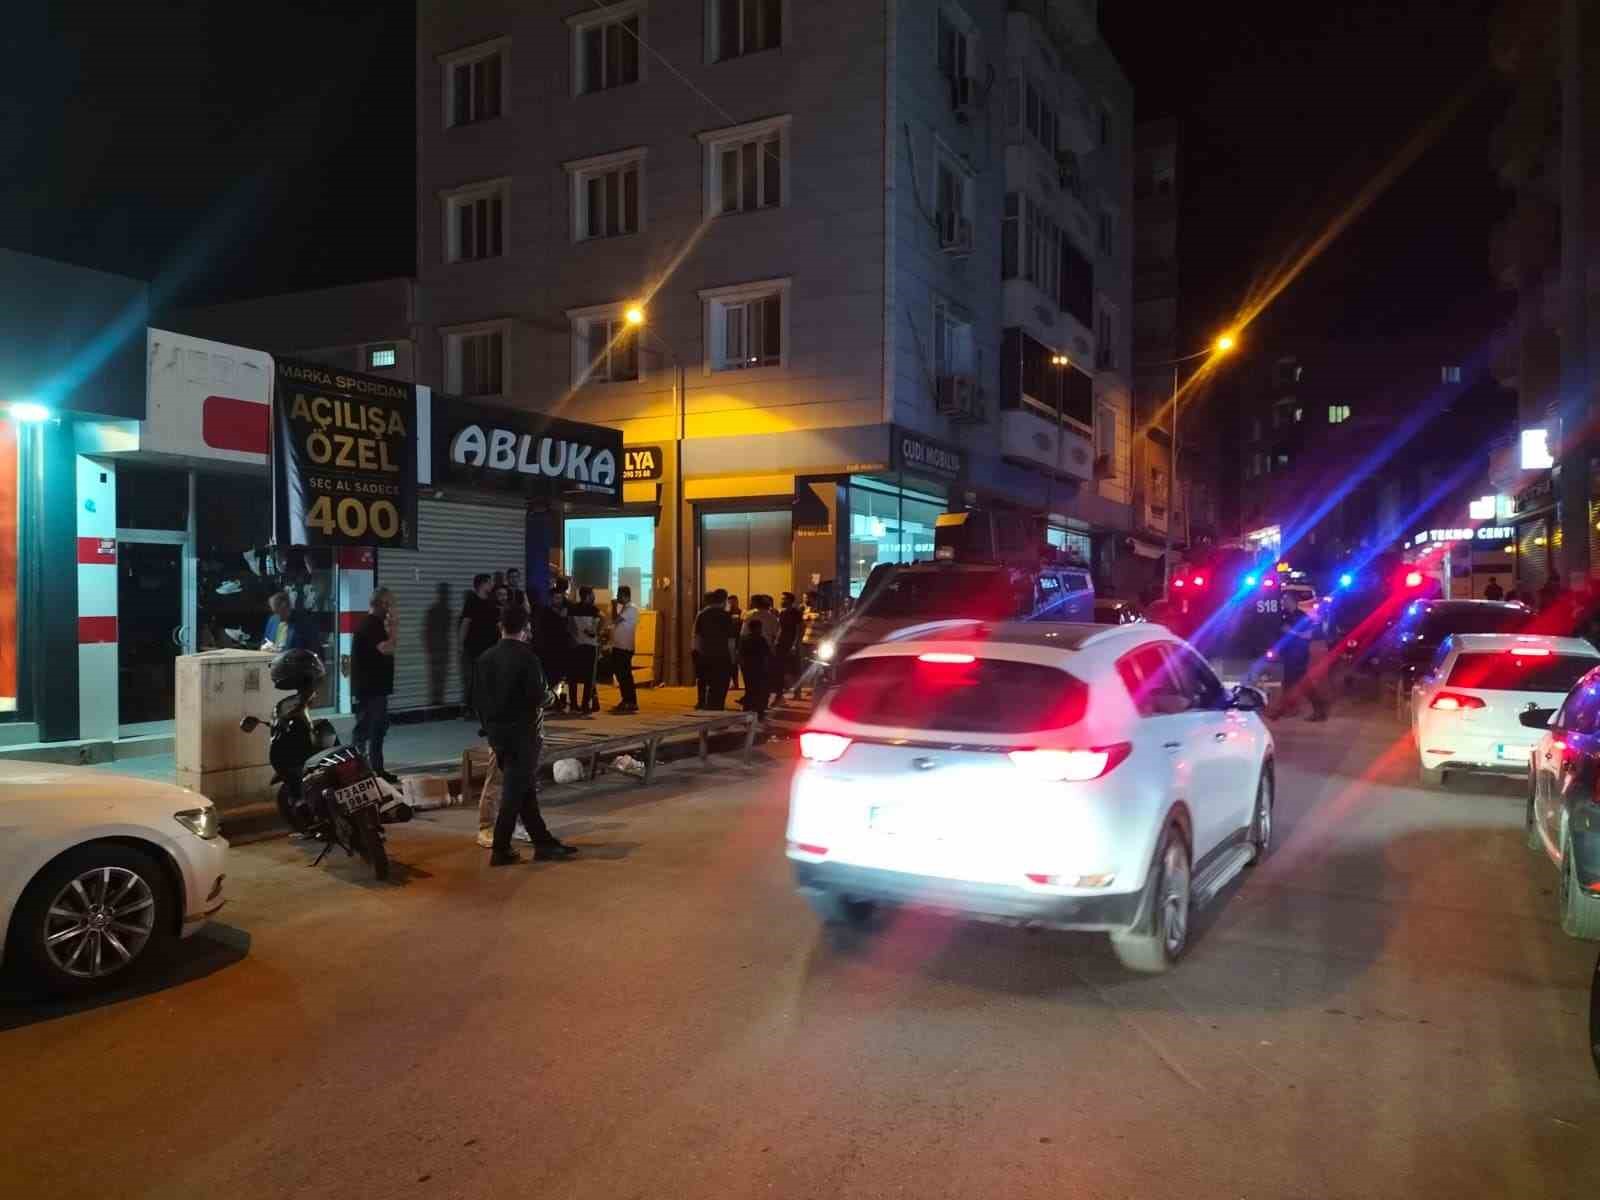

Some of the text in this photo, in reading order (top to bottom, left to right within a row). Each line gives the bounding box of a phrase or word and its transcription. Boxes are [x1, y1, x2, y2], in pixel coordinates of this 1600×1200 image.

[280, 365, 407, 400] MARKA SPORDAN
[291, 394, 407, 440] AÇILIŞA
[306, 427, 399, 472] ÖZEL
[453, 424, 616, 486] ABLUKA
[336, 479, 351, 492] AL
[307, 495, 400, 538] 400
